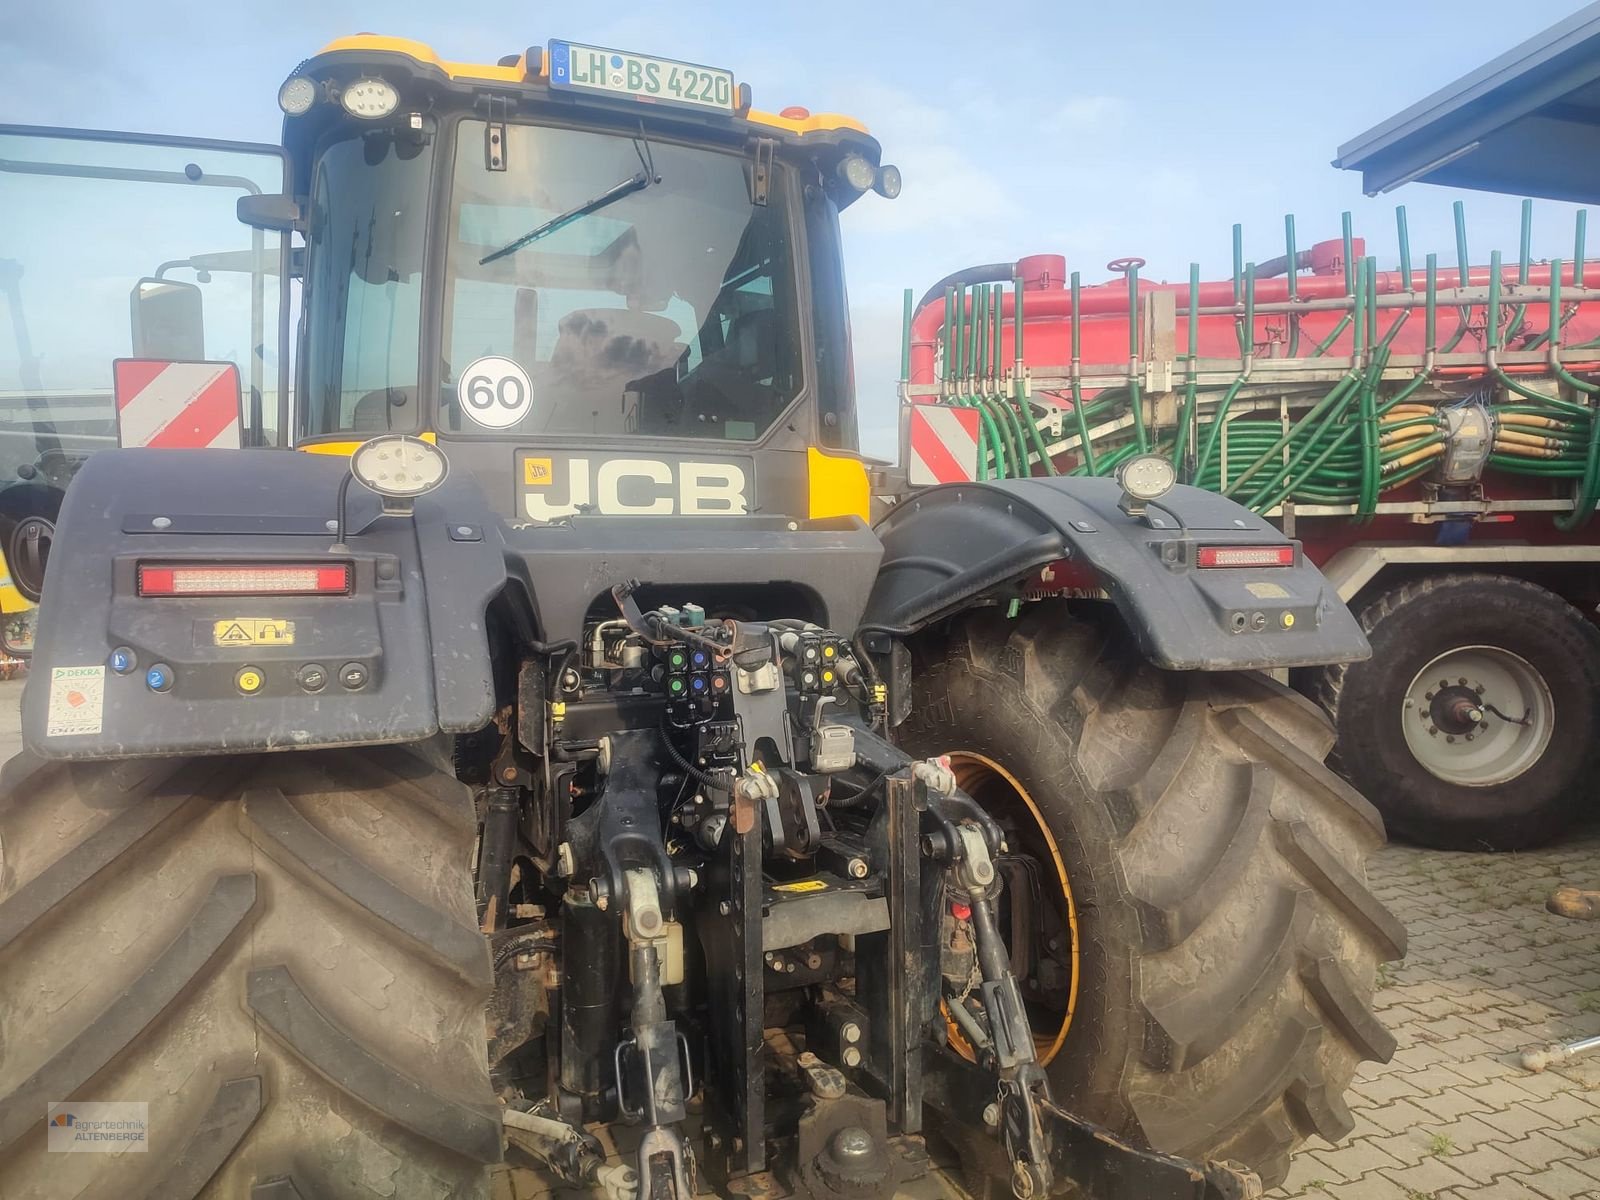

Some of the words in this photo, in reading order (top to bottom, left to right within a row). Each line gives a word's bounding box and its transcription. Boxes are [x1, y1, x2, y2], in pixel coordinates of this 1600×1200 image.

[557, 67, 565, 76] D
[571, 50, 607, 86] LH
[627, 59, 661, 93] BS
[668, 67, 729, 105] 4220
[467, 375, 525, 410] 60
[525, 458, 748, 521] JCB
[67, 669, 100, 677] DEKRA
